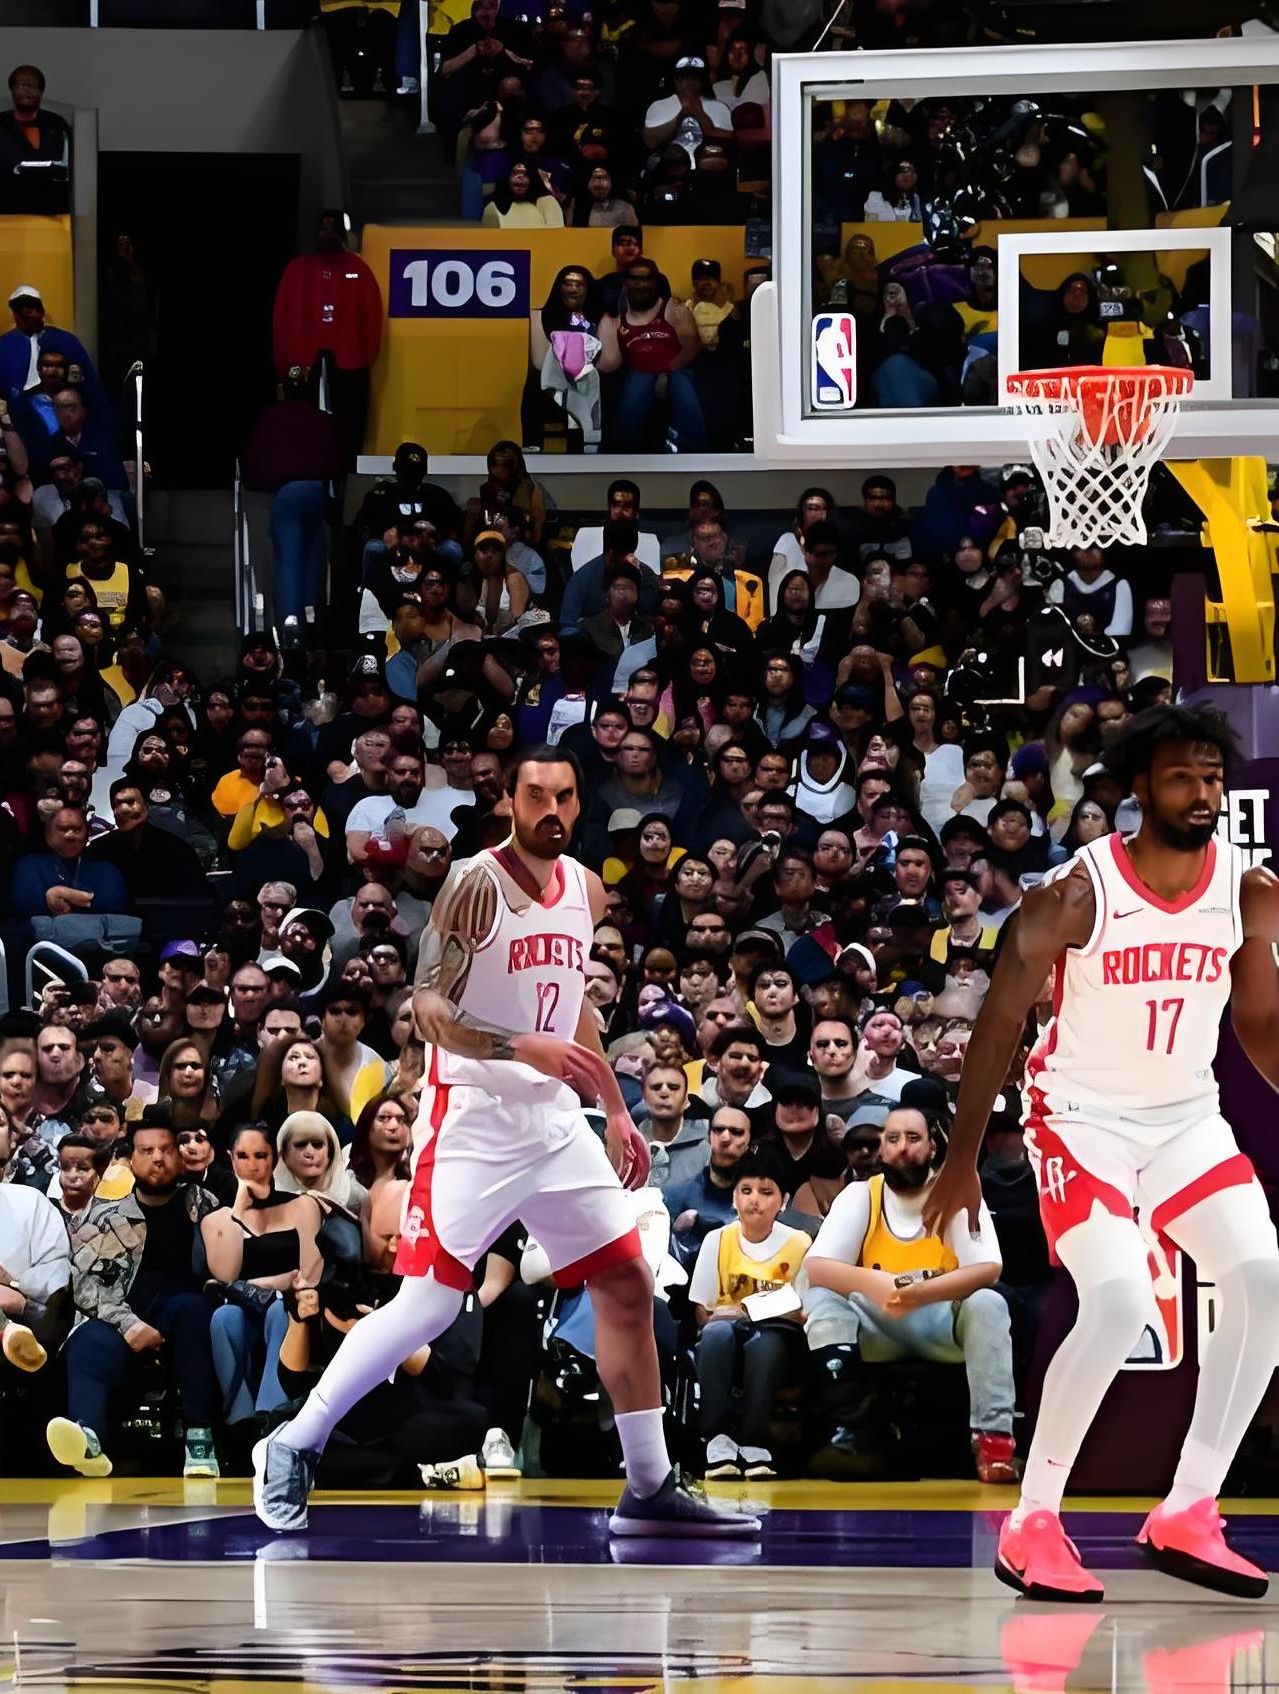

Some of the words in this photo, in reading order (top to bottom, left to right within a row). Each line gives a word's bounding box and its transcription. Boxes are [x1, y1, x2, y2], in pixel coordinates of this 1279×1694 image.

[403, 260, 516, 307] 106
[1103, 943, 1228, 985] ROCKETS
[535, 981, 560, 1033] 12
[1145, 998, 1185, 1055] 17
